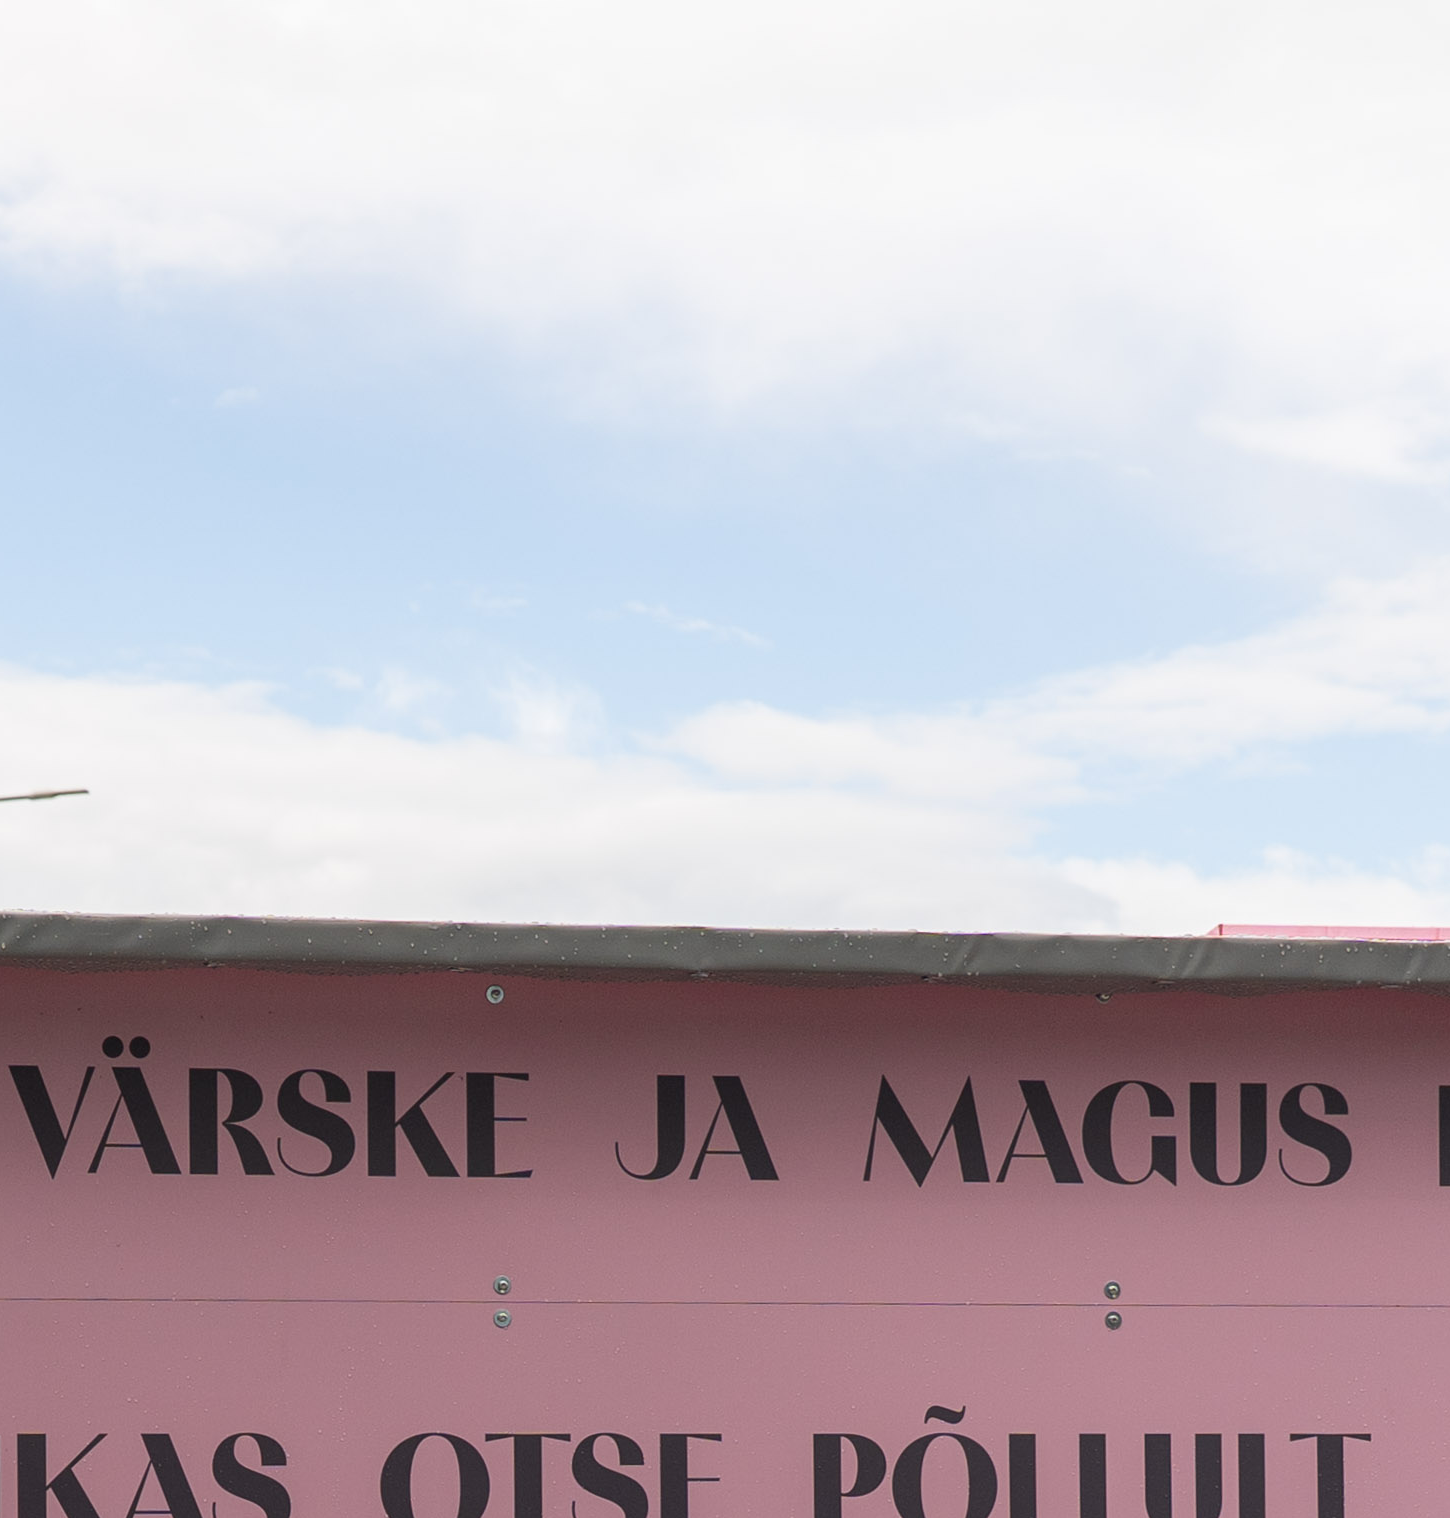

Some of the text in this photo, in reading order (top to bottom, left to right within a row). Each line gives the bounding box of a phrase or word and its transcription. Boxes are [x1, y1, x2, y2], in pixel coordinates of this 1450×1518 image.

[8, 1036, 532, 1179] VÄRSKE
[616, 1075, 779, 1180] JA
[864, 1074, 1352, 1187] MAGUS
